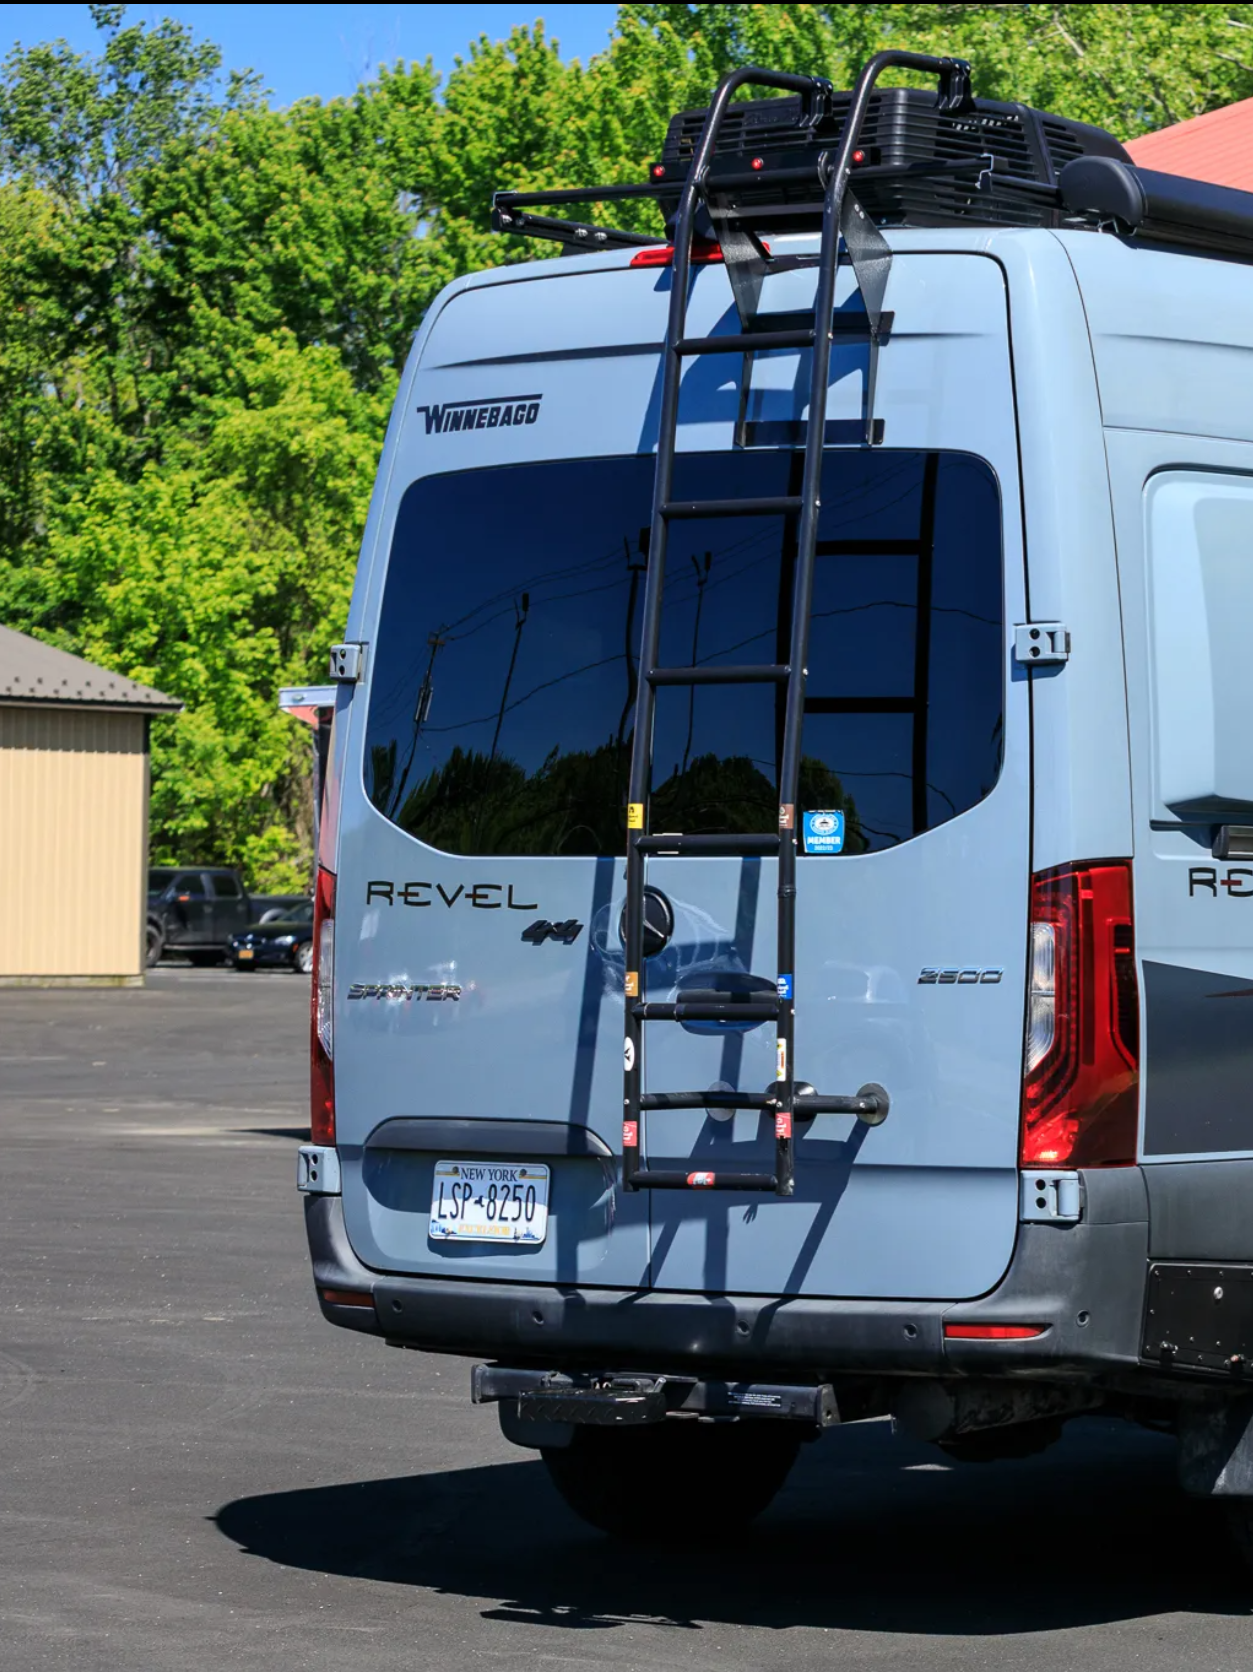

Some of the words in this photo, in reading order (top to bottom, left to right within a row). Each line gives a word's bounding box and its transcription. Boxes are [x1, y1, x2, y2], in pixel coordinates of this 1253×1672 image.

[417, 393, 543, 435] WINNEBAGO
[807, 836, 841, 845] MEMBER
[366, 880, 538, 910] REVEL
[917, 967, 1004, 985] 2500
[347, 983, 462, 1001] SPRINTER
[460, 1167, 486, 1181] NEW
[488, 1168, 519, 1182] YORK
[438, 1181, 473, 1220] LSP
[486, 1183, 536, 1223] 8250
